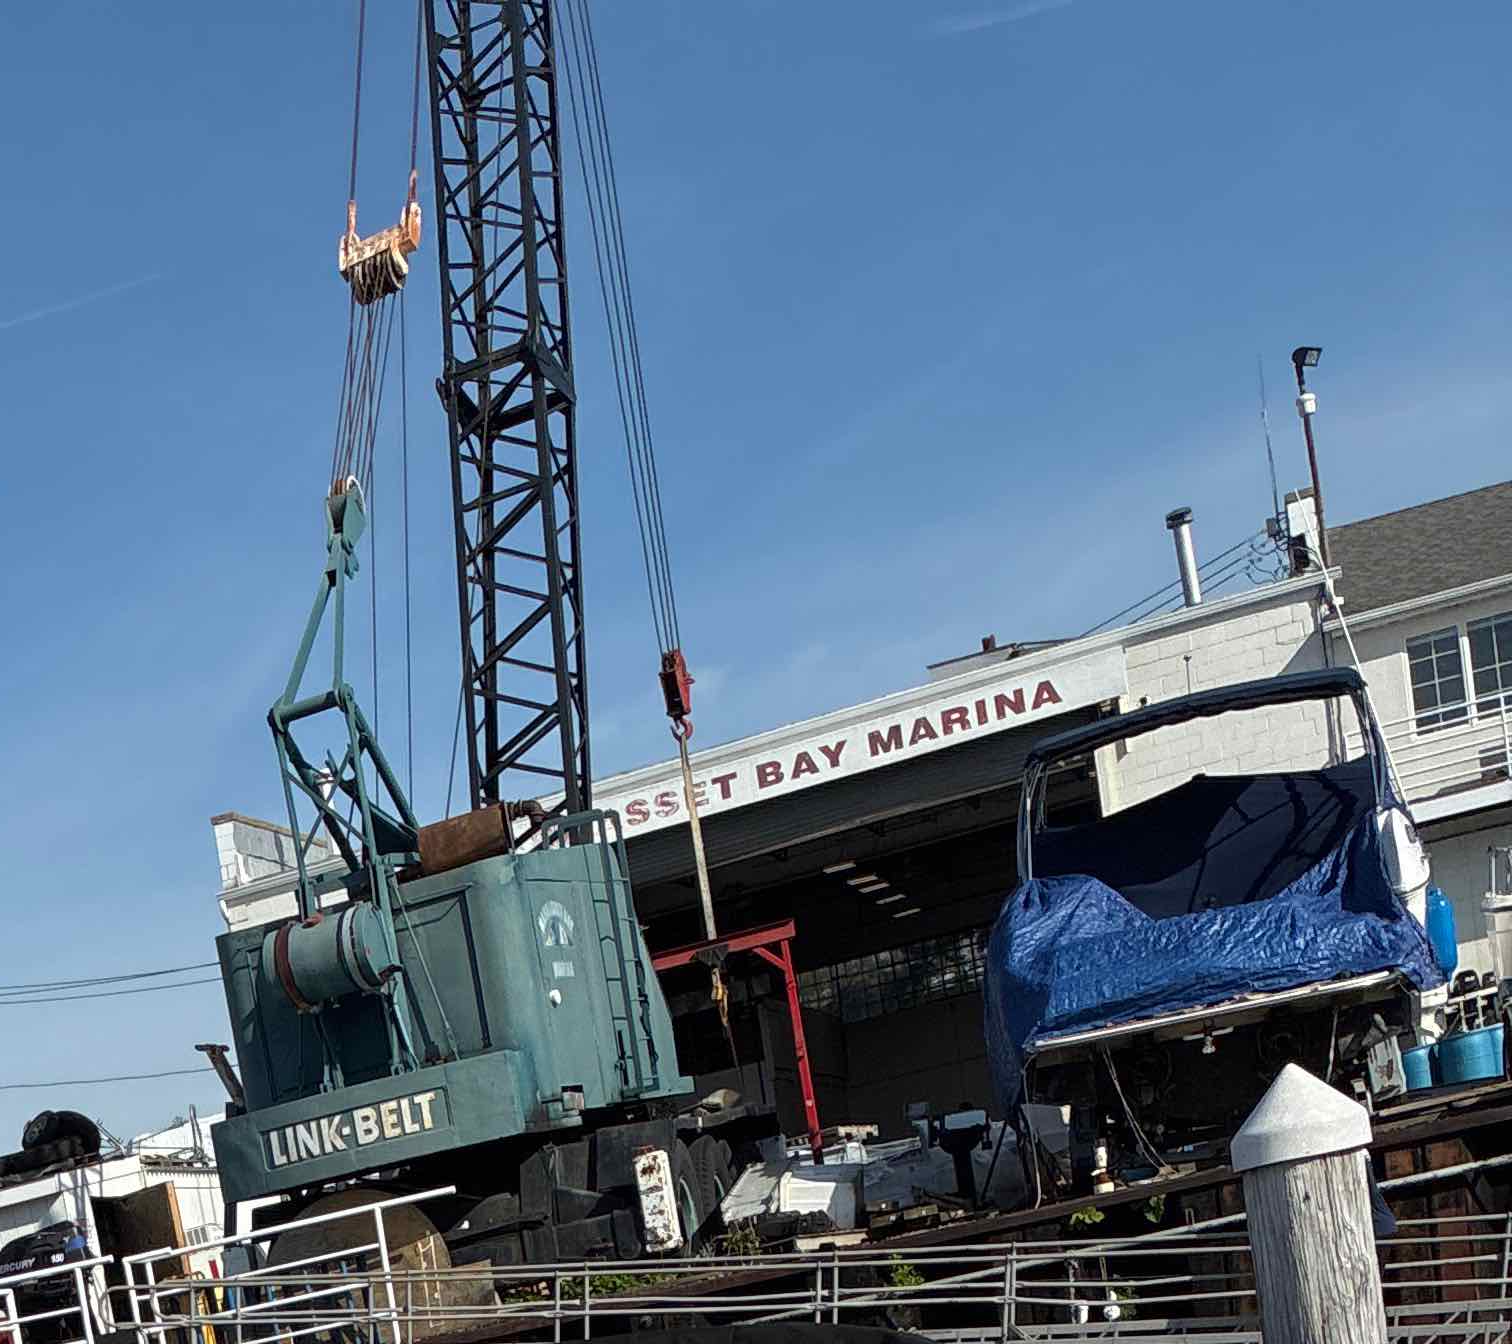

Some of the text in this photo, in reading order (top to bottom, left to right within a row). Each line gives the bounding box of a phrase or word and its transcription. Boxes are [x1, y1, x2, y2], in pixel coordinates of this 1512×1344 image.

[618, 679, 1063, 826] SSET BAY MARINA
[269, 1091, 436, 1166] LINK-BELT
